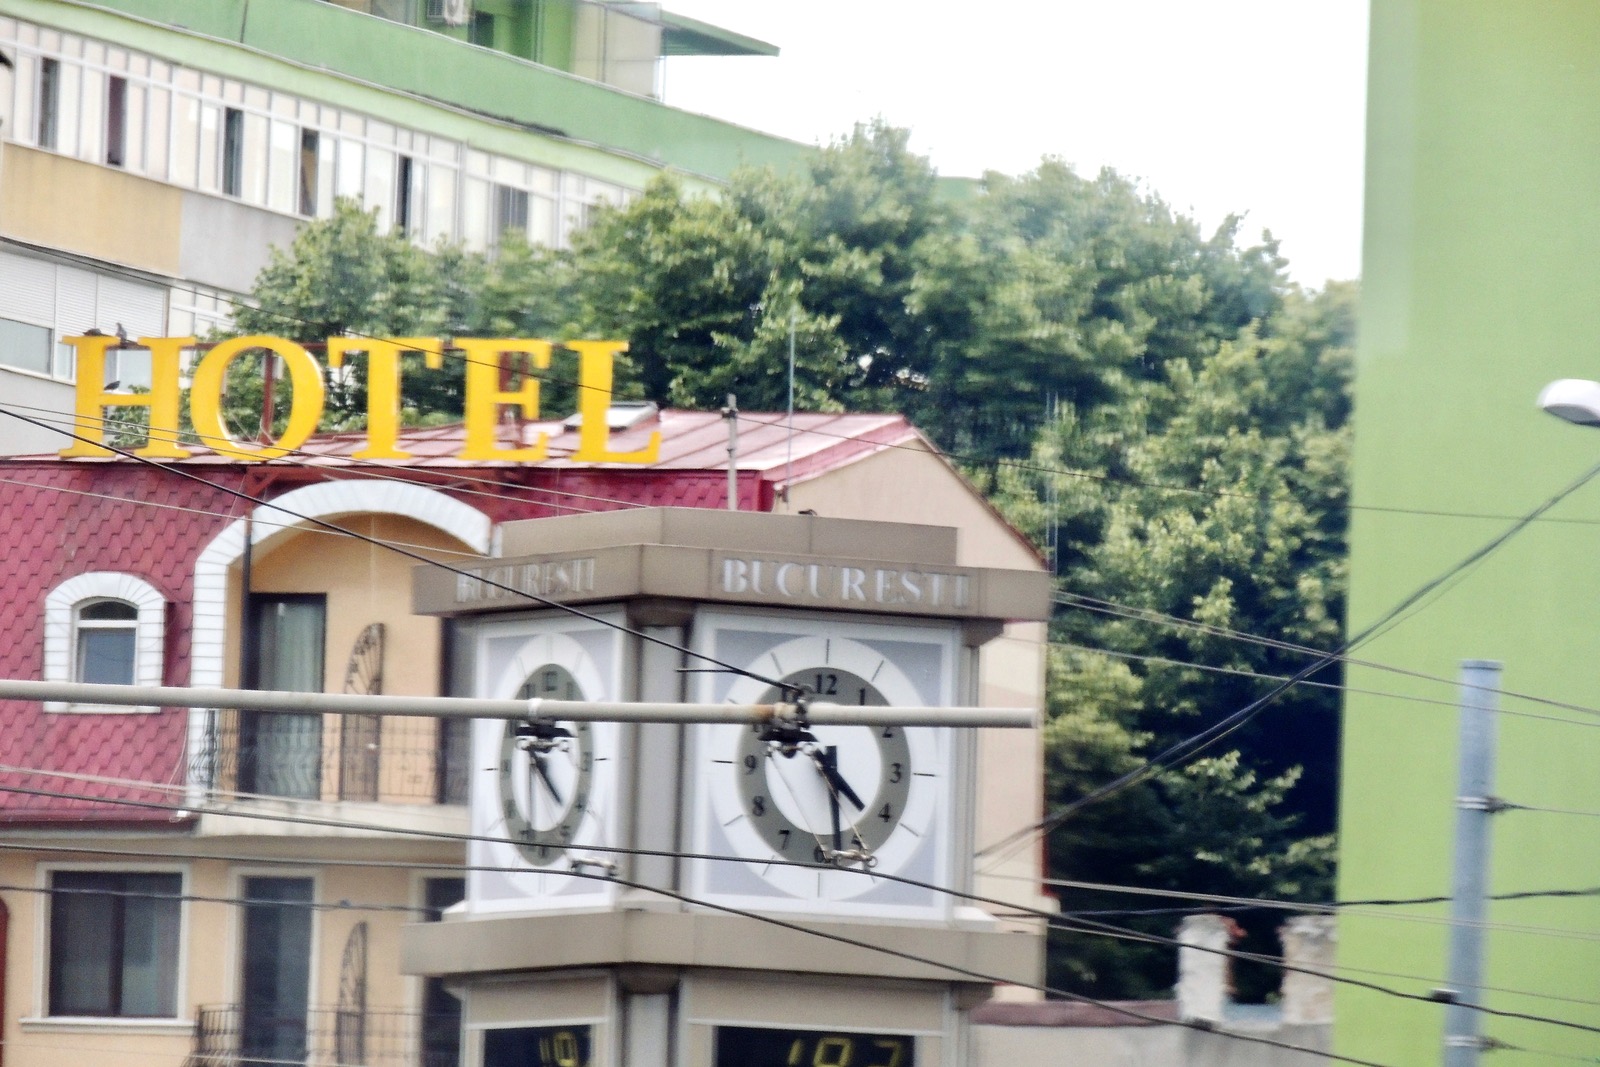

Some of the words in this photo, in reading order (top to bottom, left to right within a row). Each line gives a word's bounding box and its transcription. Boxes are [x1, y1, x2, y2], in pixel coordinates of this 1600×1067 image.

[58, 334, 660, 463] HOTEL
[723, 558, 971, 609] BUCURESTI
[815, 674, 837, 695] 12
[744, 754, 757, 775] 9
[889, 762, 902, 784] 3
[752, 795, 765, 817] 8
[878, 803, 891, 823] 4
[779, 830, 790, 851] 7
